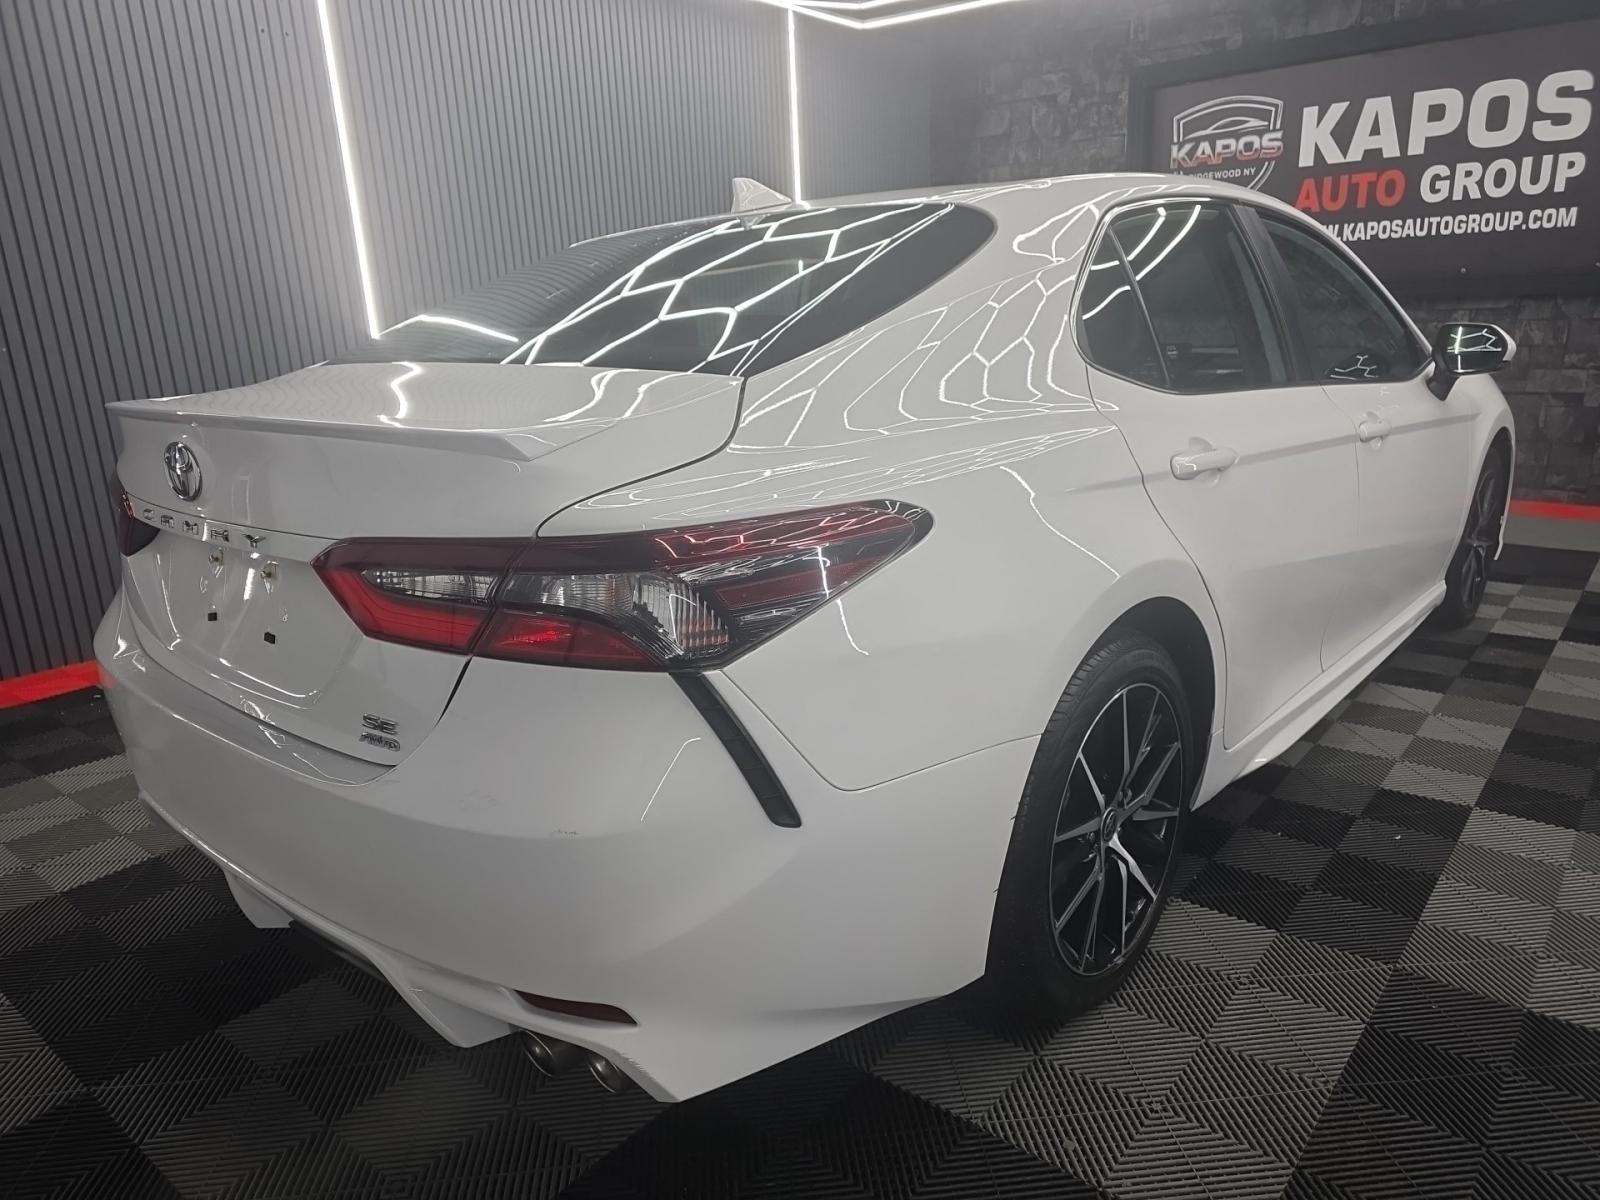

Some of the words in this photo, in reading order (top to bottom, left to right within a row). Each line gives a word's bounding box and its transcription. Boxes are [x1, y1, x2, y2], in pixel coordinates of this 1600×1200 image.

[1298, 69, 1594, 167] KAPOS
[1170, 130, 1284, 169] KAPOS
[1189, 168, 1241, 180] IDGEWOOD
[1243, 167, 1257, 176] NY
[1295, 169, 1406, 212] AUTO
[1420, 152, 1586, 203] GROUP
[362, 714, 398, 735] SE
